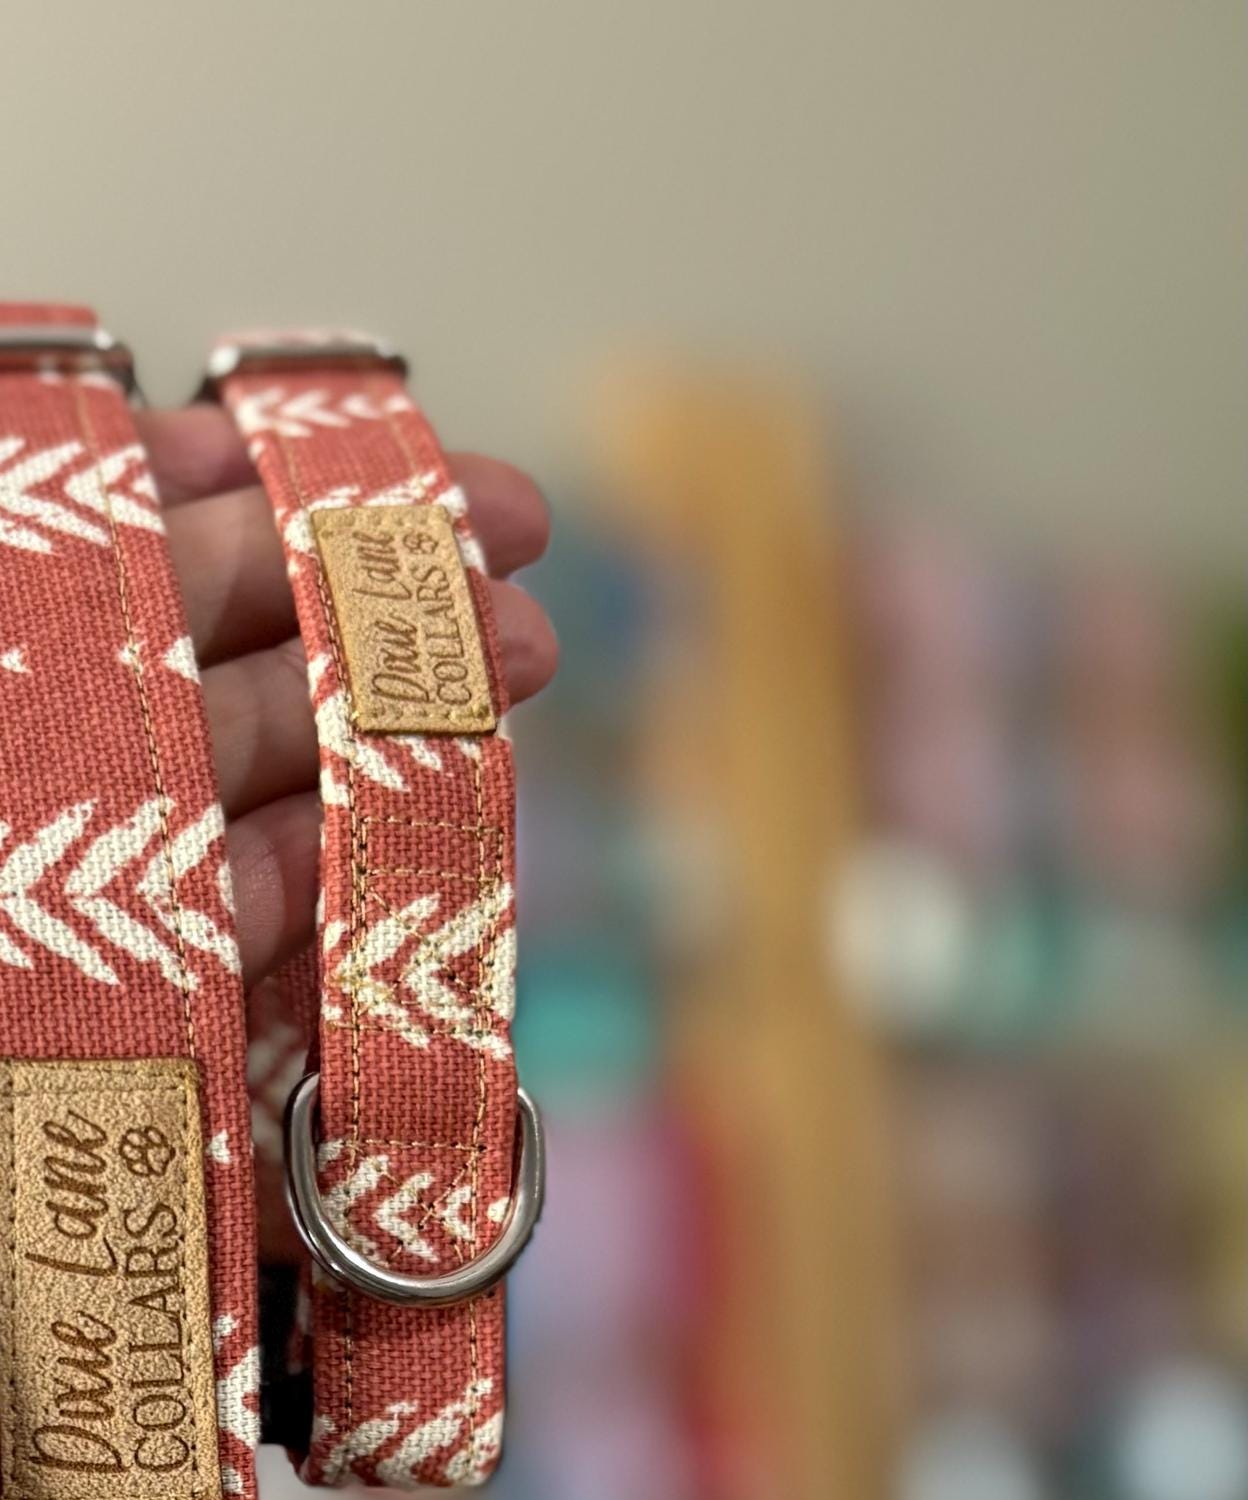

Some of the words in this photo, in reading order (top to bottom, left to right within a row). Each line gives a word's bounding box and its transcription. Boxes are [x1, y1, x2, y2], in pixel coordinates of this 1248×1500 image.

[352, 531, 412, 600] Lane
[410, 566, 472, 704] COLLARS
[371, 611, 435, 703] Dixie
[25, 1109, 118, 1275] Lane
[29, 1311, 129, 1473] Dixie
[123, 1203, 190, 1471] COLLARS
